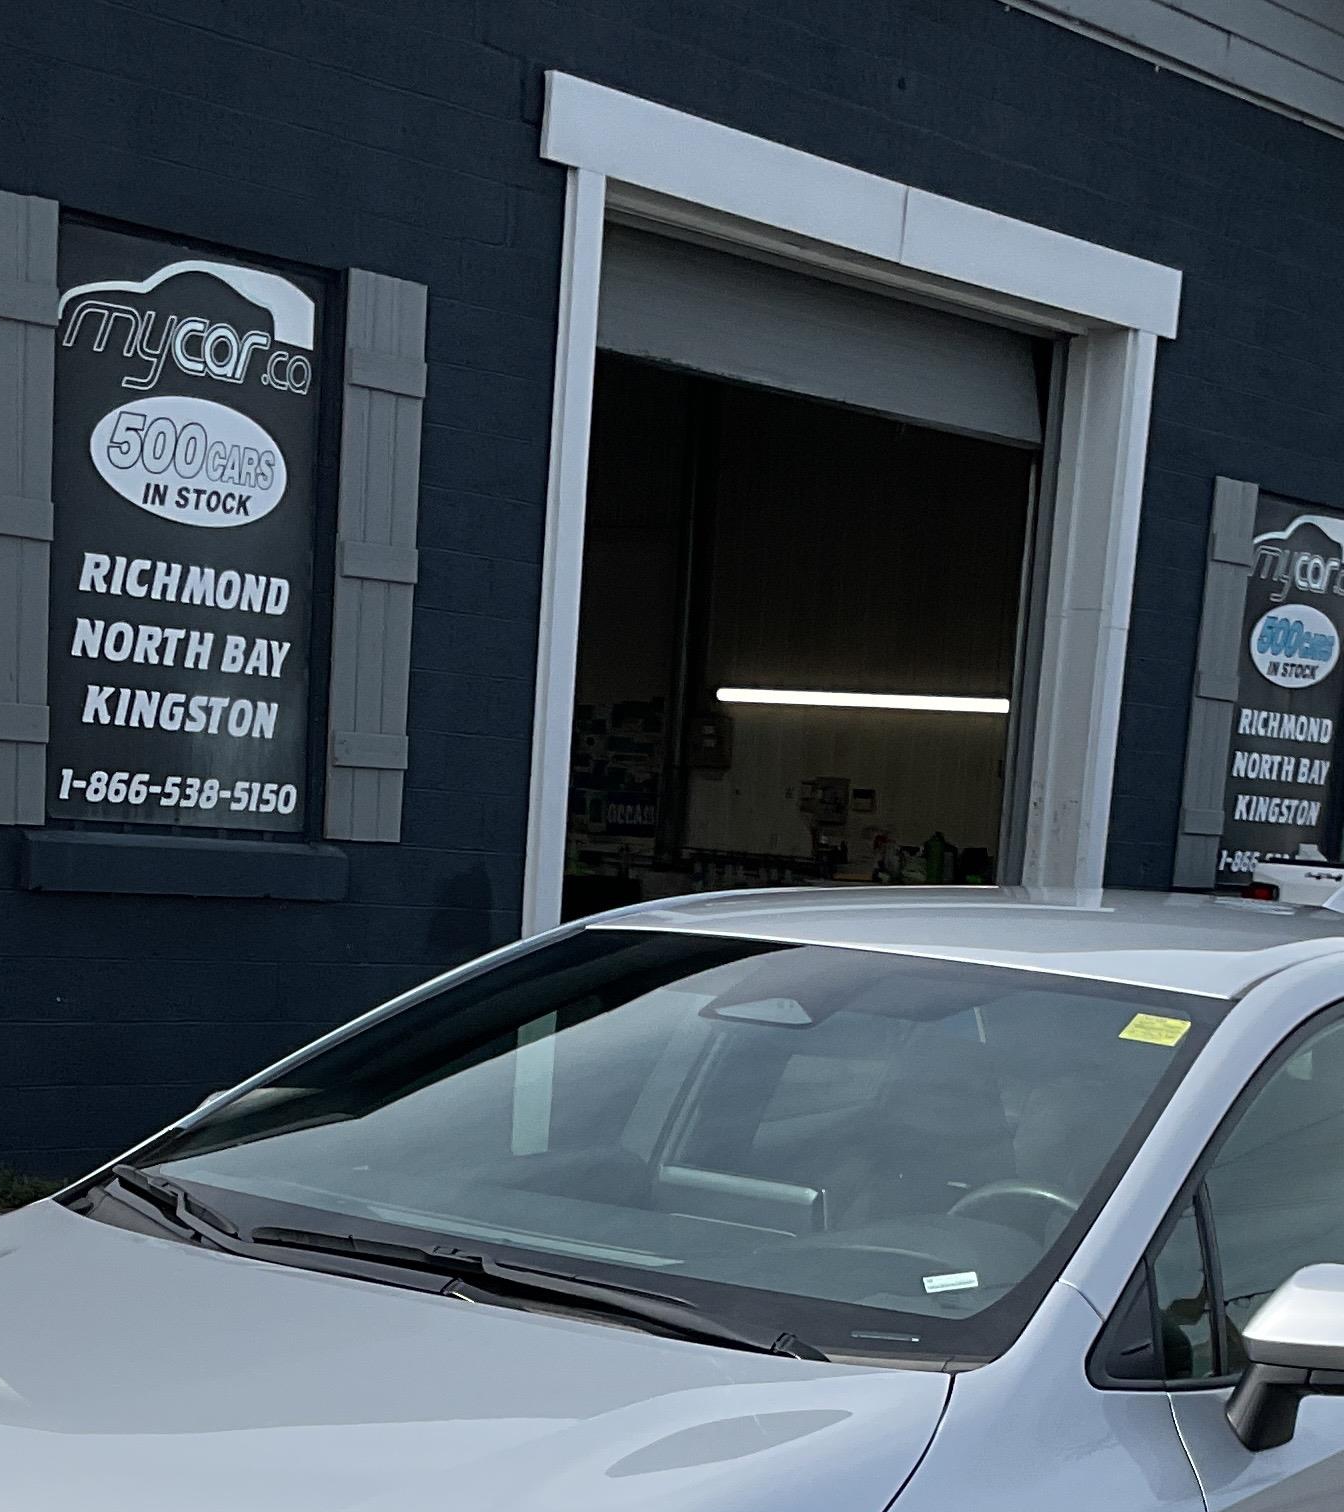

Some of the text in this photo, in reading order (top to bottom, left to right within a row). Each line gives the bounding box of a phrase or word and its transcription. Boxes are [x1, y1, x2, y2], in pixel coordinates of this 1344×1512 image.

[142, 482, 251, 516] IN STOCK
[78, 552, 290, 616] RICHMOND
[70, 617, 291, 678] NORTH BAY
[1266, 660, 1320, 680] IN STOCK
[81, 684, 279, 739] KINGSTON
[1237, 708, 1334, 744] RICHMOND
[1232, 750, 1331, 786] NORTH BAY
[58, 768, 298, 815] 1-866-538-5150
[1233, 794, 1321, 827] KINGSTON
